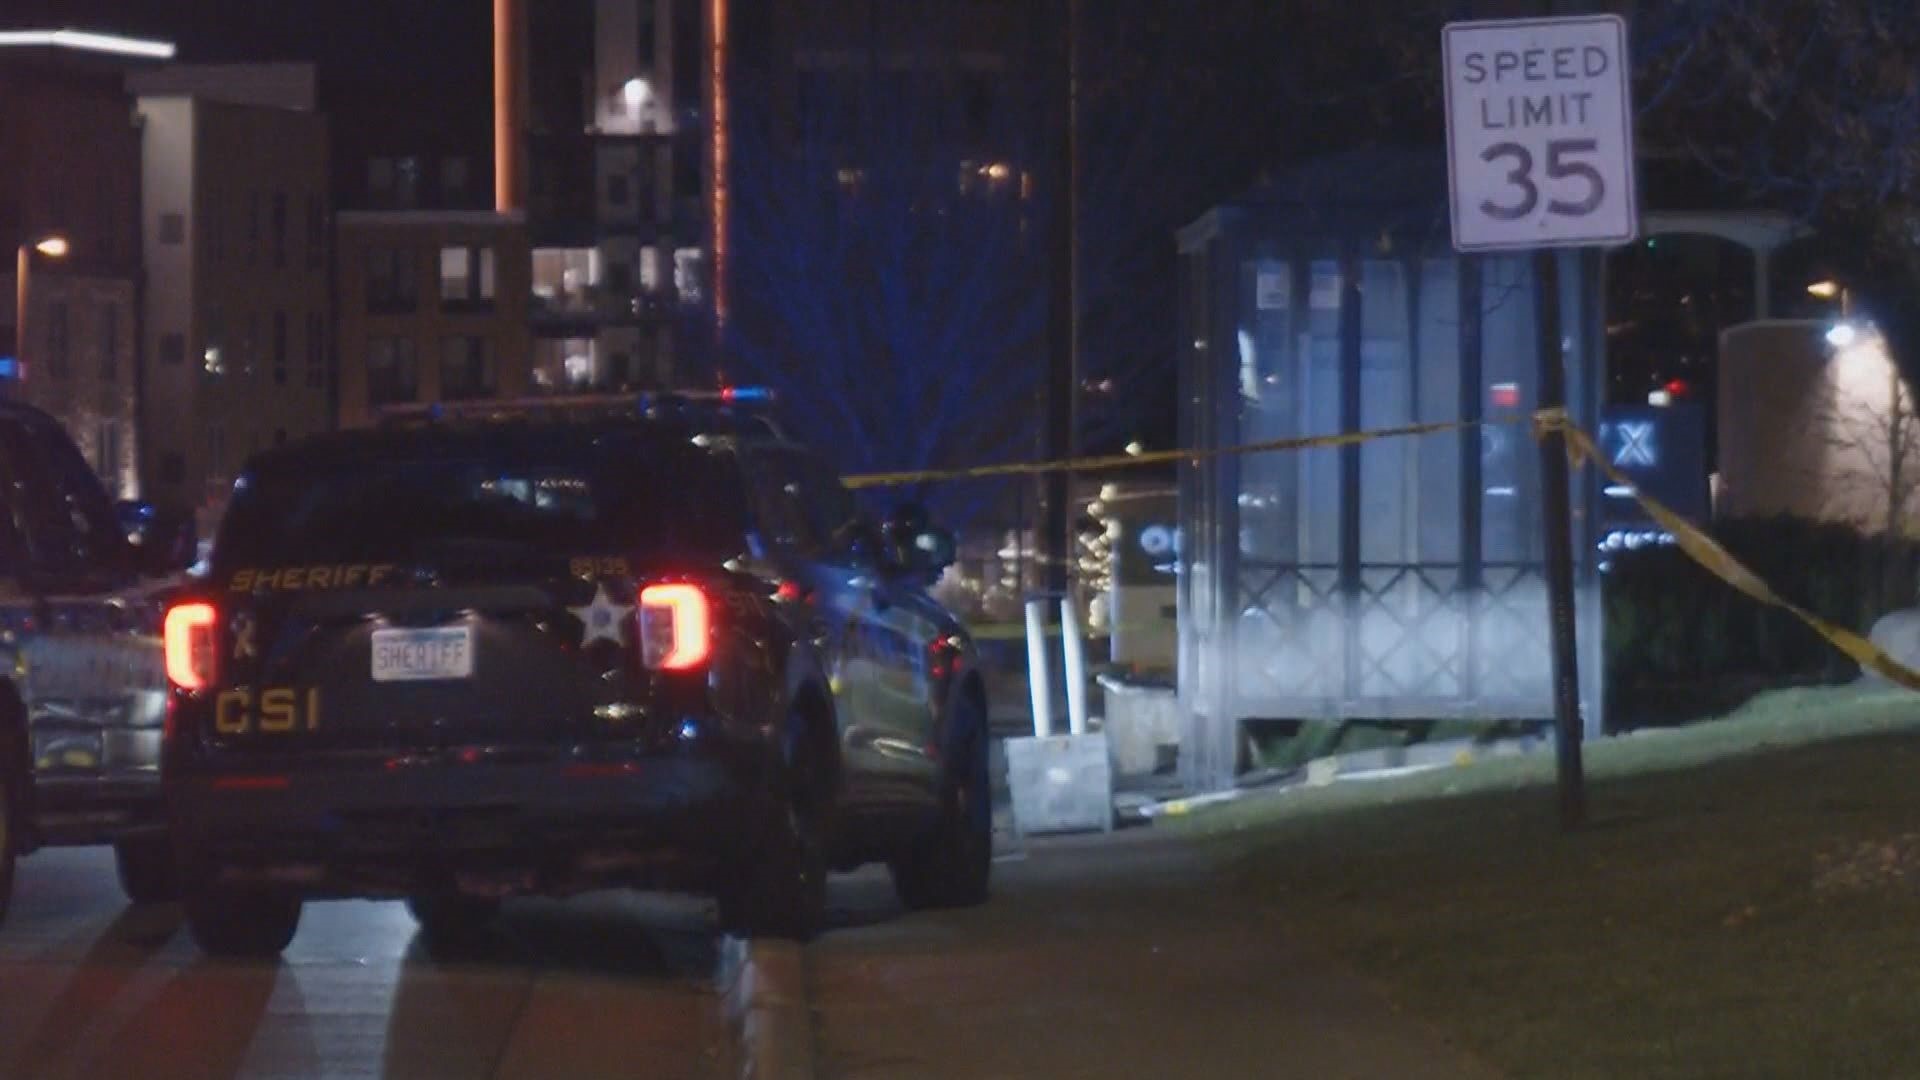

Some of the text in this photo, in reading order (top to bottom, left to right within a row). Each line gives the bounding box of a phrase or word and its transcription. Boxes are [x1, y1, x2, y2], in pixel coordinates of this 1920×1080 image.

[1463, 45, 1608, 84] SPEED
[1481, 92, 1593, 128] LIMIT
[1479, 139, 1605, 221] 35
[229, 564, 394, 591] SHERIFF
[375, 641, 468, 672] SHERIFF
[216, 687, 320, 733] CSI
